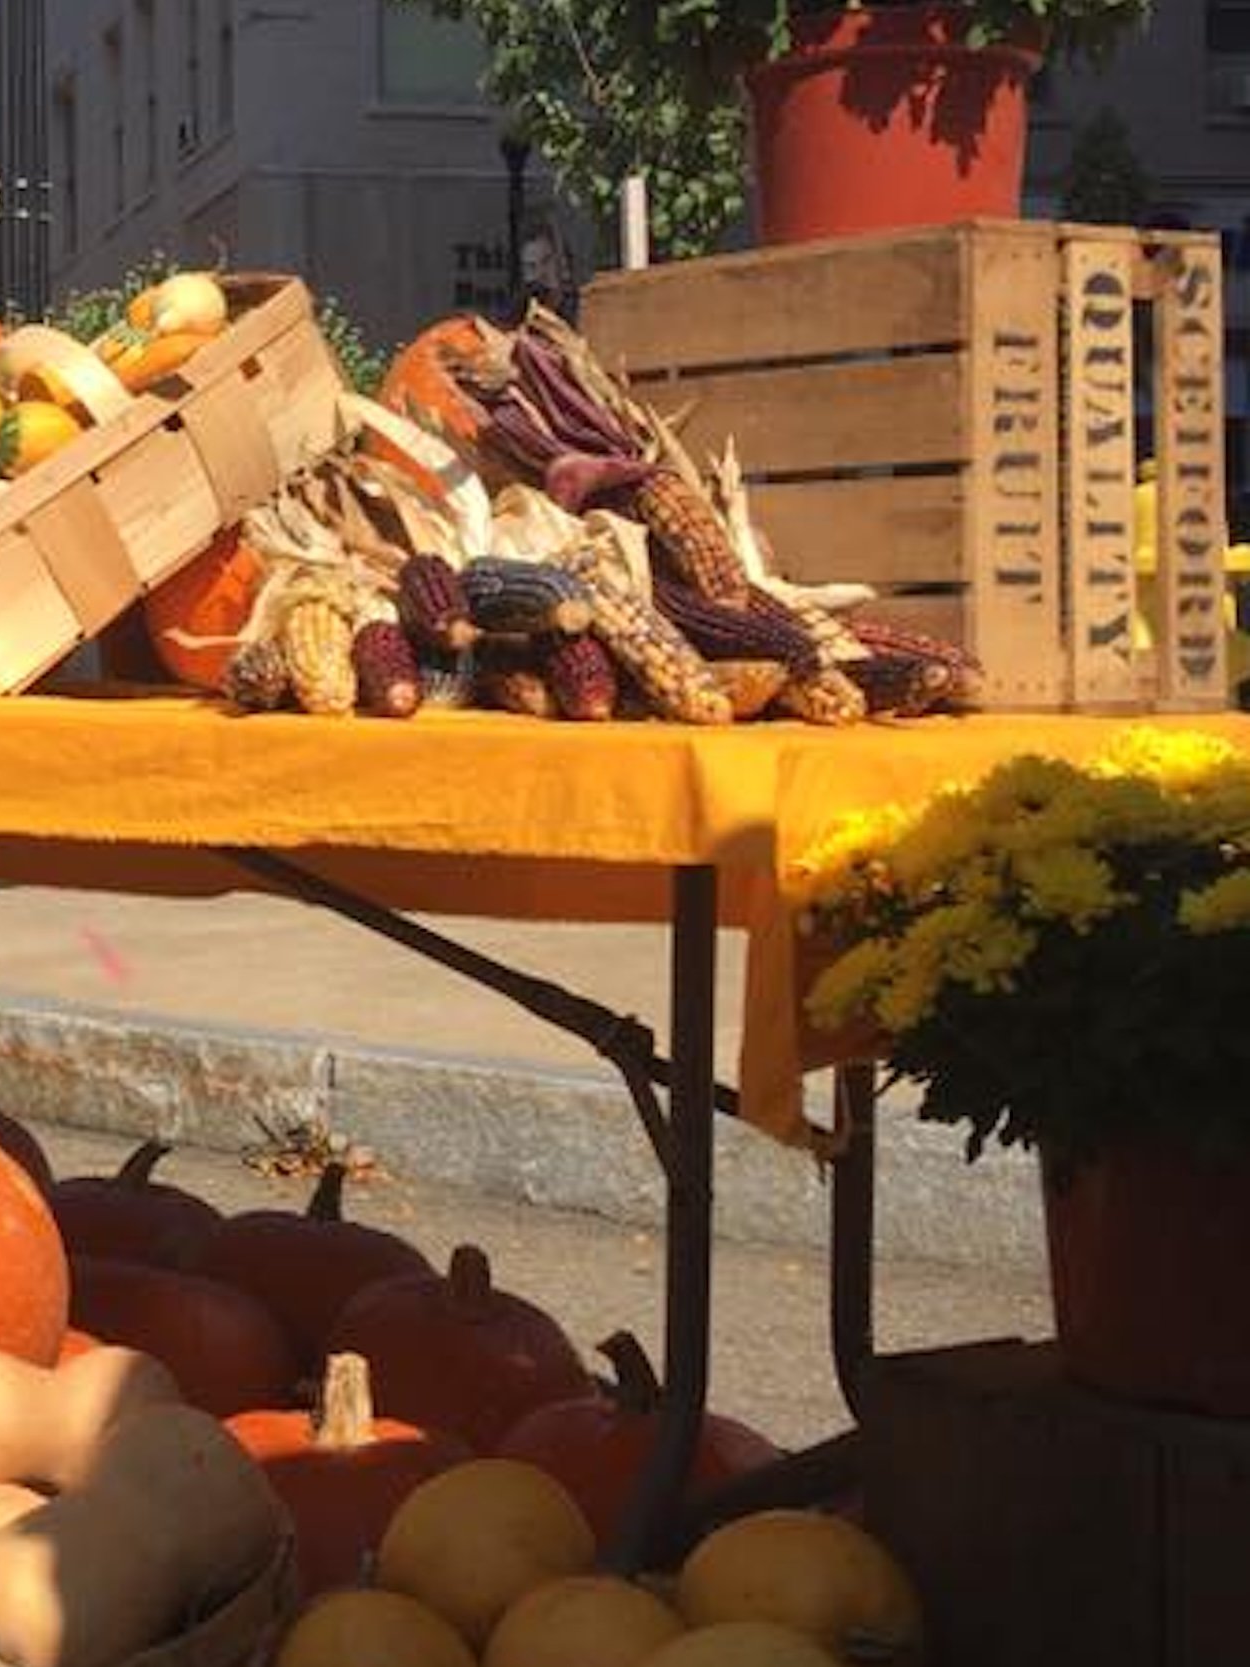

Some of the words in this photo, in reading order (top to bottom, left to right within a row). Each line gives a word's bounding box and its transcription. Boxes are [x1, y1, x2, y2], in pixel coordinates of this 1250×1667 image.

[453, 243, 511, 270] Thi
[993, 332, 1043, 604] FRUIT
[1082, 272, 1130, 664] QUALITY
